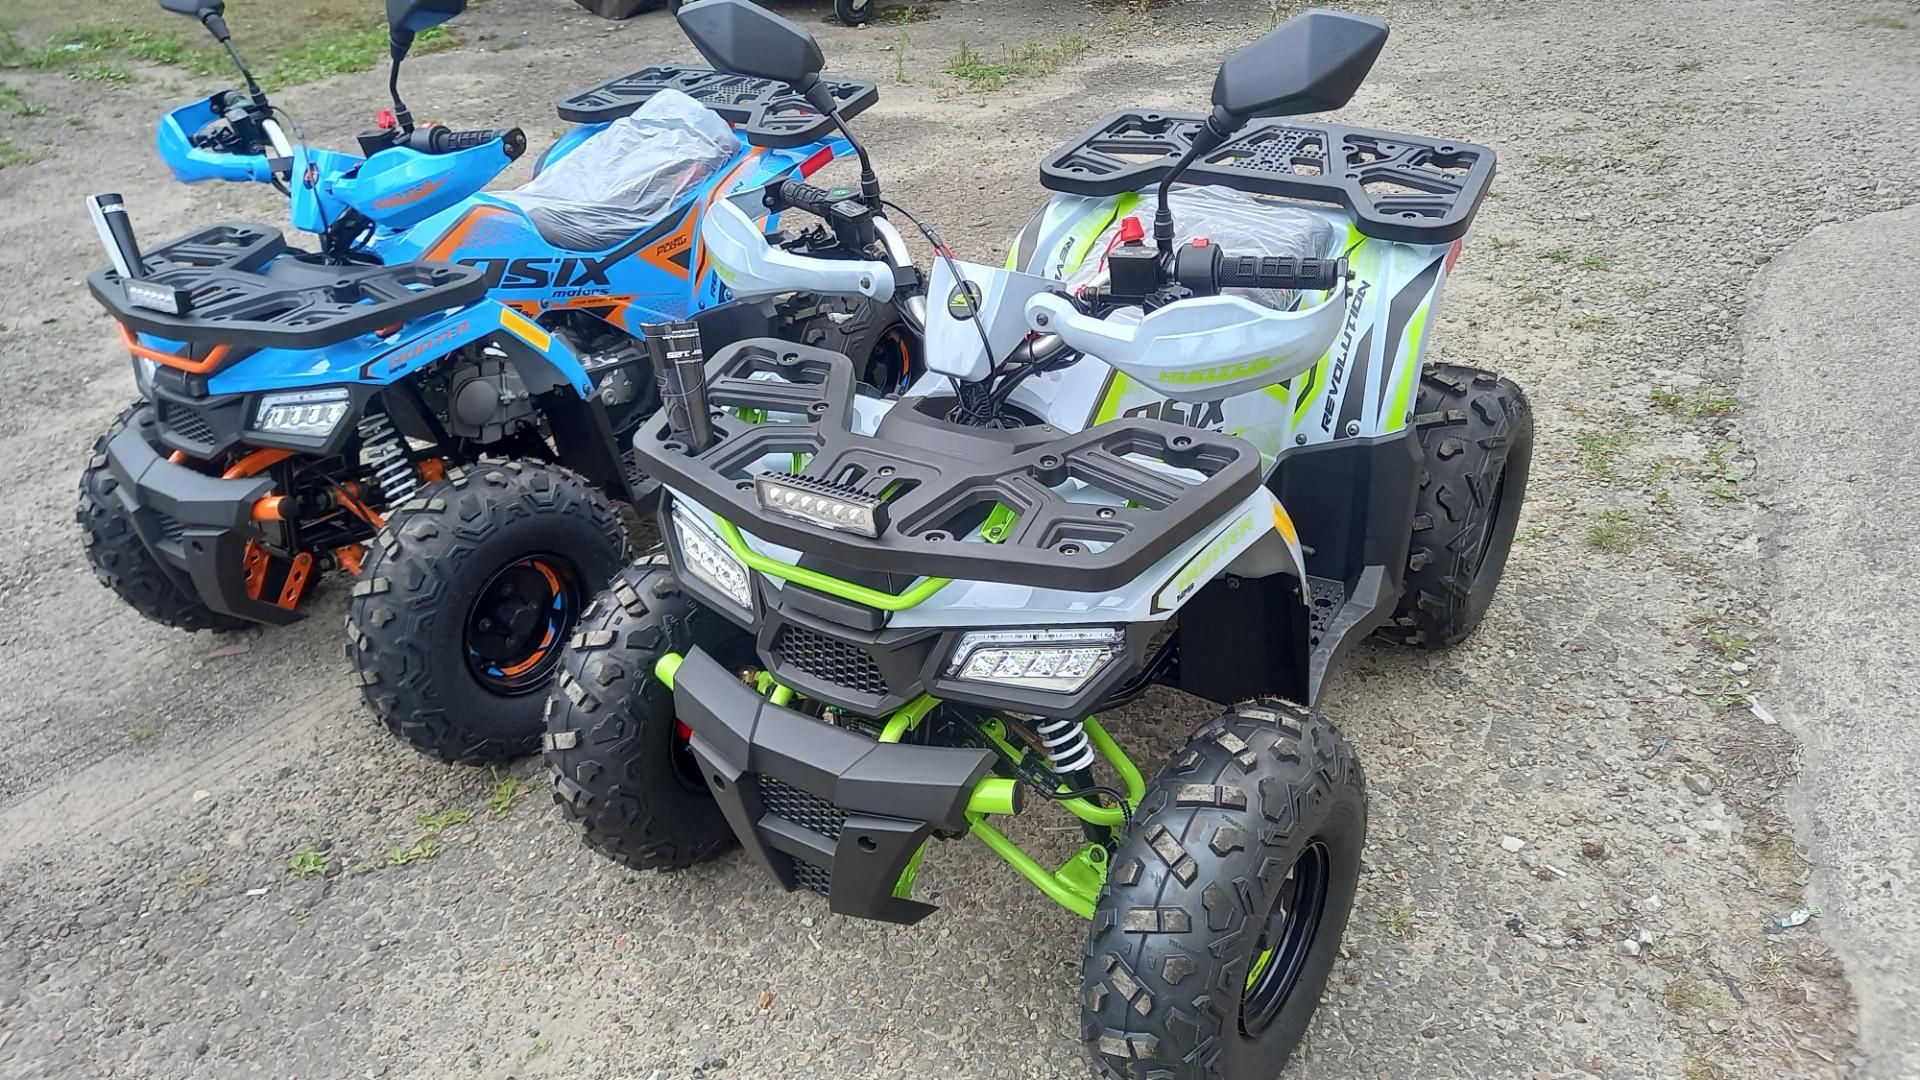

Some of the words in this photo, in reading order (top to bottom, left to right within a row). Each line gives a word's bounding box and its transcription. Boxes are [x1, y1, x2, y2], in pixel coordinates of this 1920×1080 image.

[552, 287, 611, 298] motors
[389, 320, 470, 368] HUNTER
[1321, 280, 1372, 433] REVOLUTION
[1177, 515, 1254, 593] HUNTER
